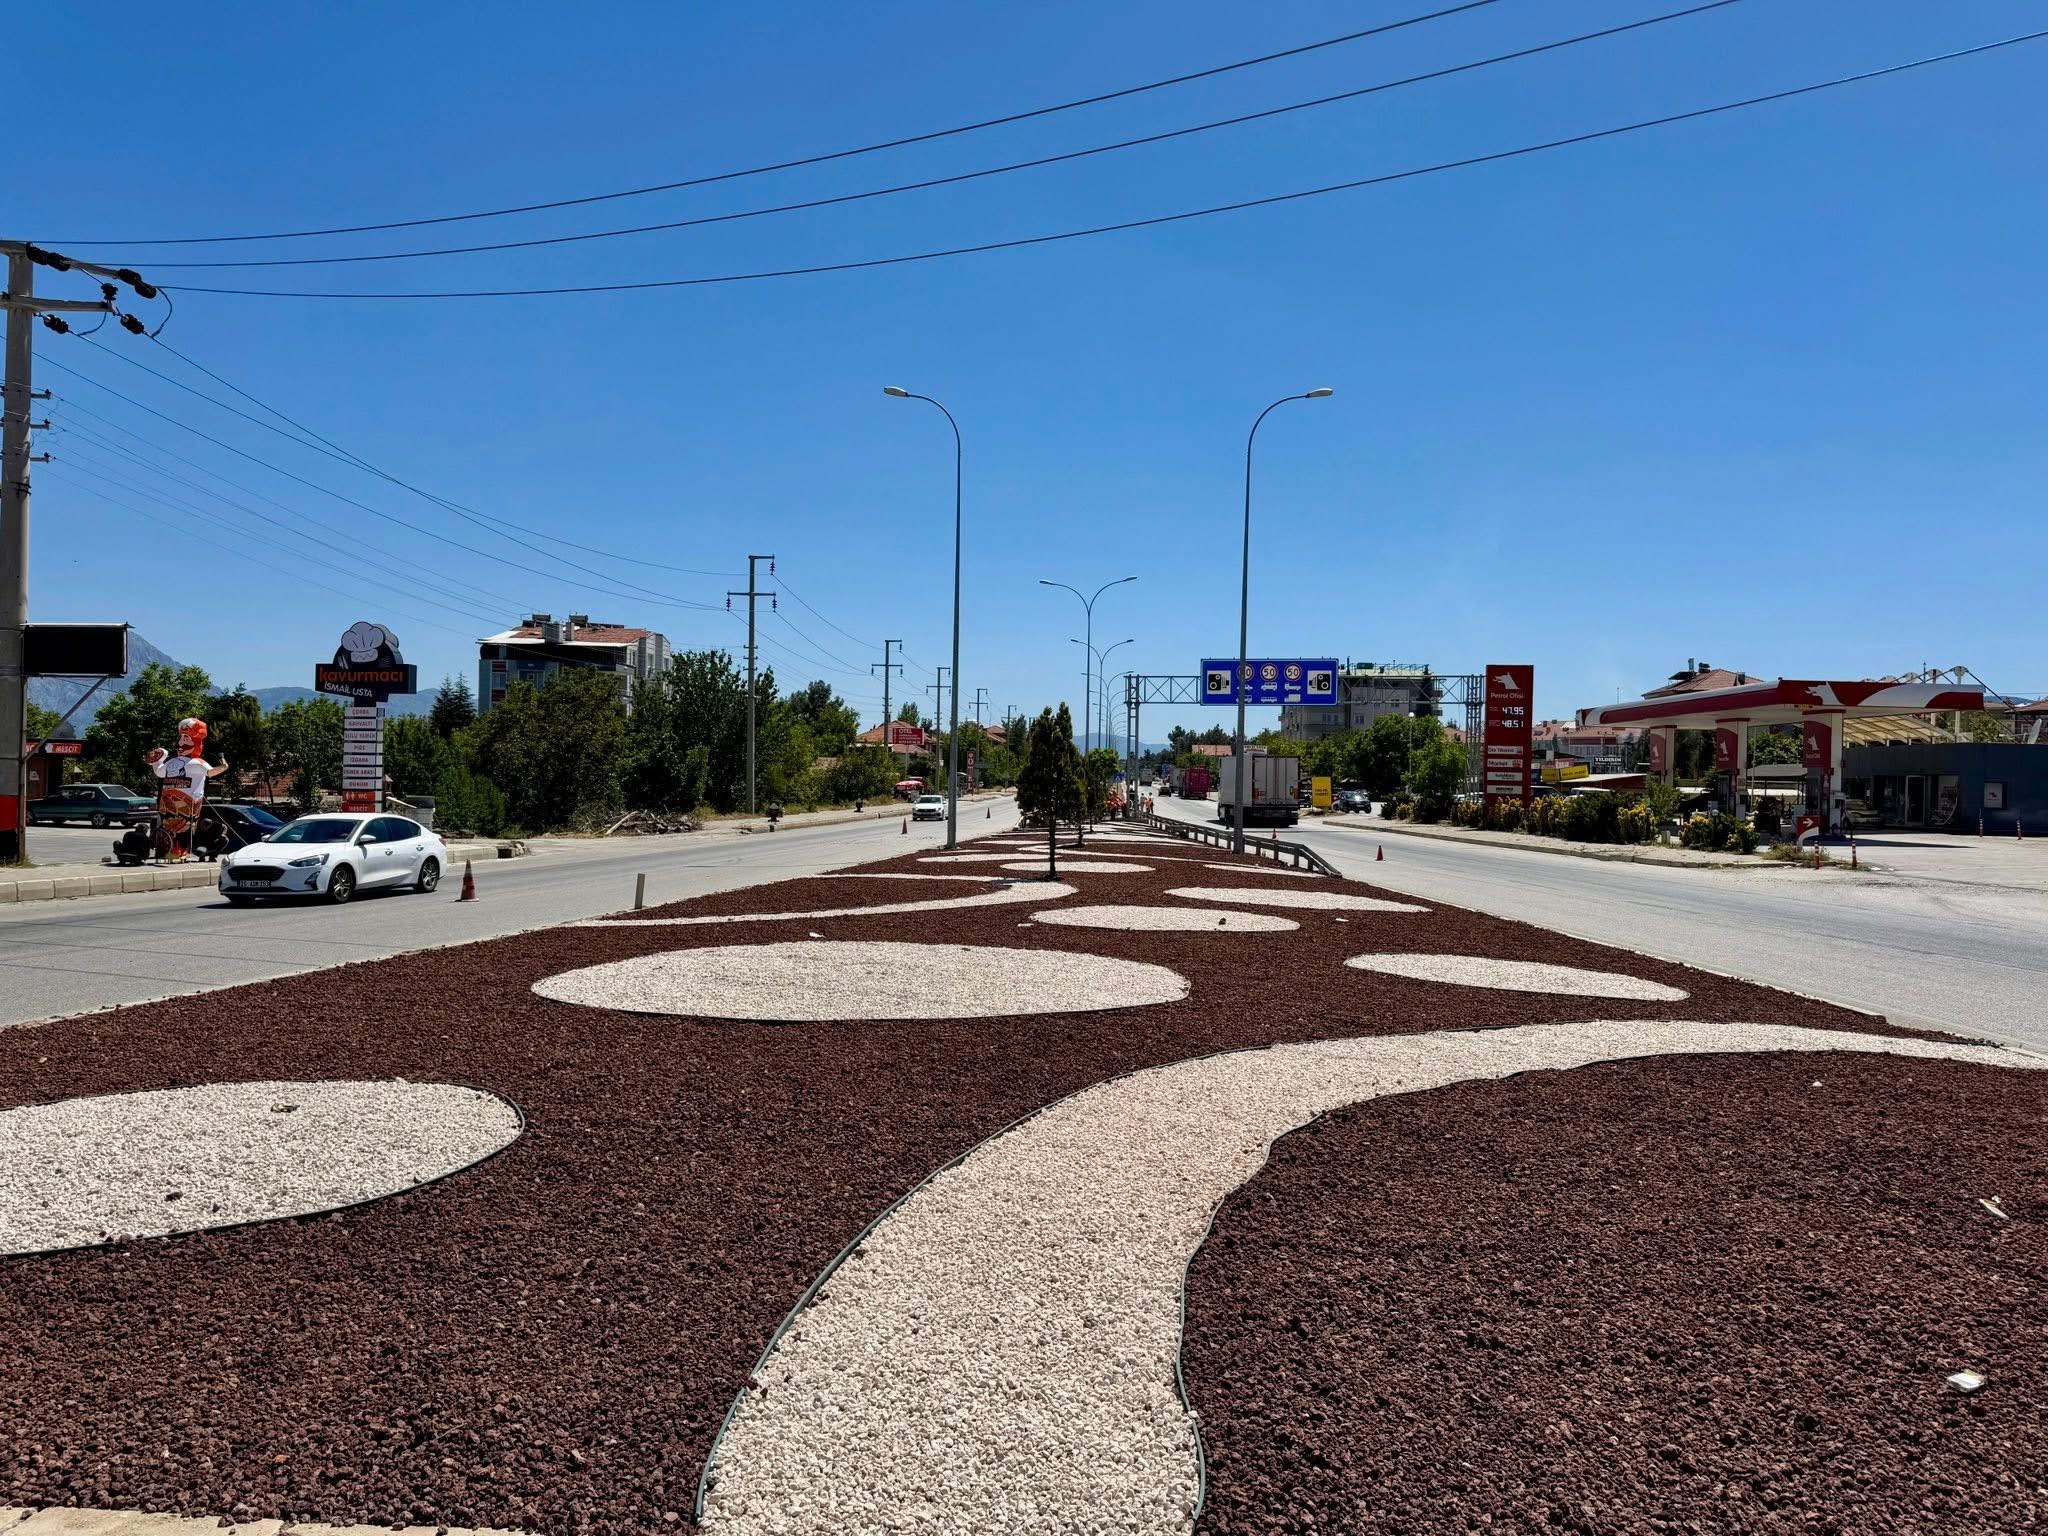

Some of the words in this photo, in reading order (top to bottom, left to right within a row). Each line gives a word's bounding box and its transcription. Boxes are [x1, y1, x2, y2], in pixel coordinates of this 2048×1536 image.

[319, 666, 404, 682] kavurmacı
[1263, 668, 1275, 677] 50
[1287, 668, 1299, 677] 50
[352, 688, 373, 697] USTA
[1502, 706, 1524, 715] 47.95
[1501, 719, 1524, 728] 48.51
